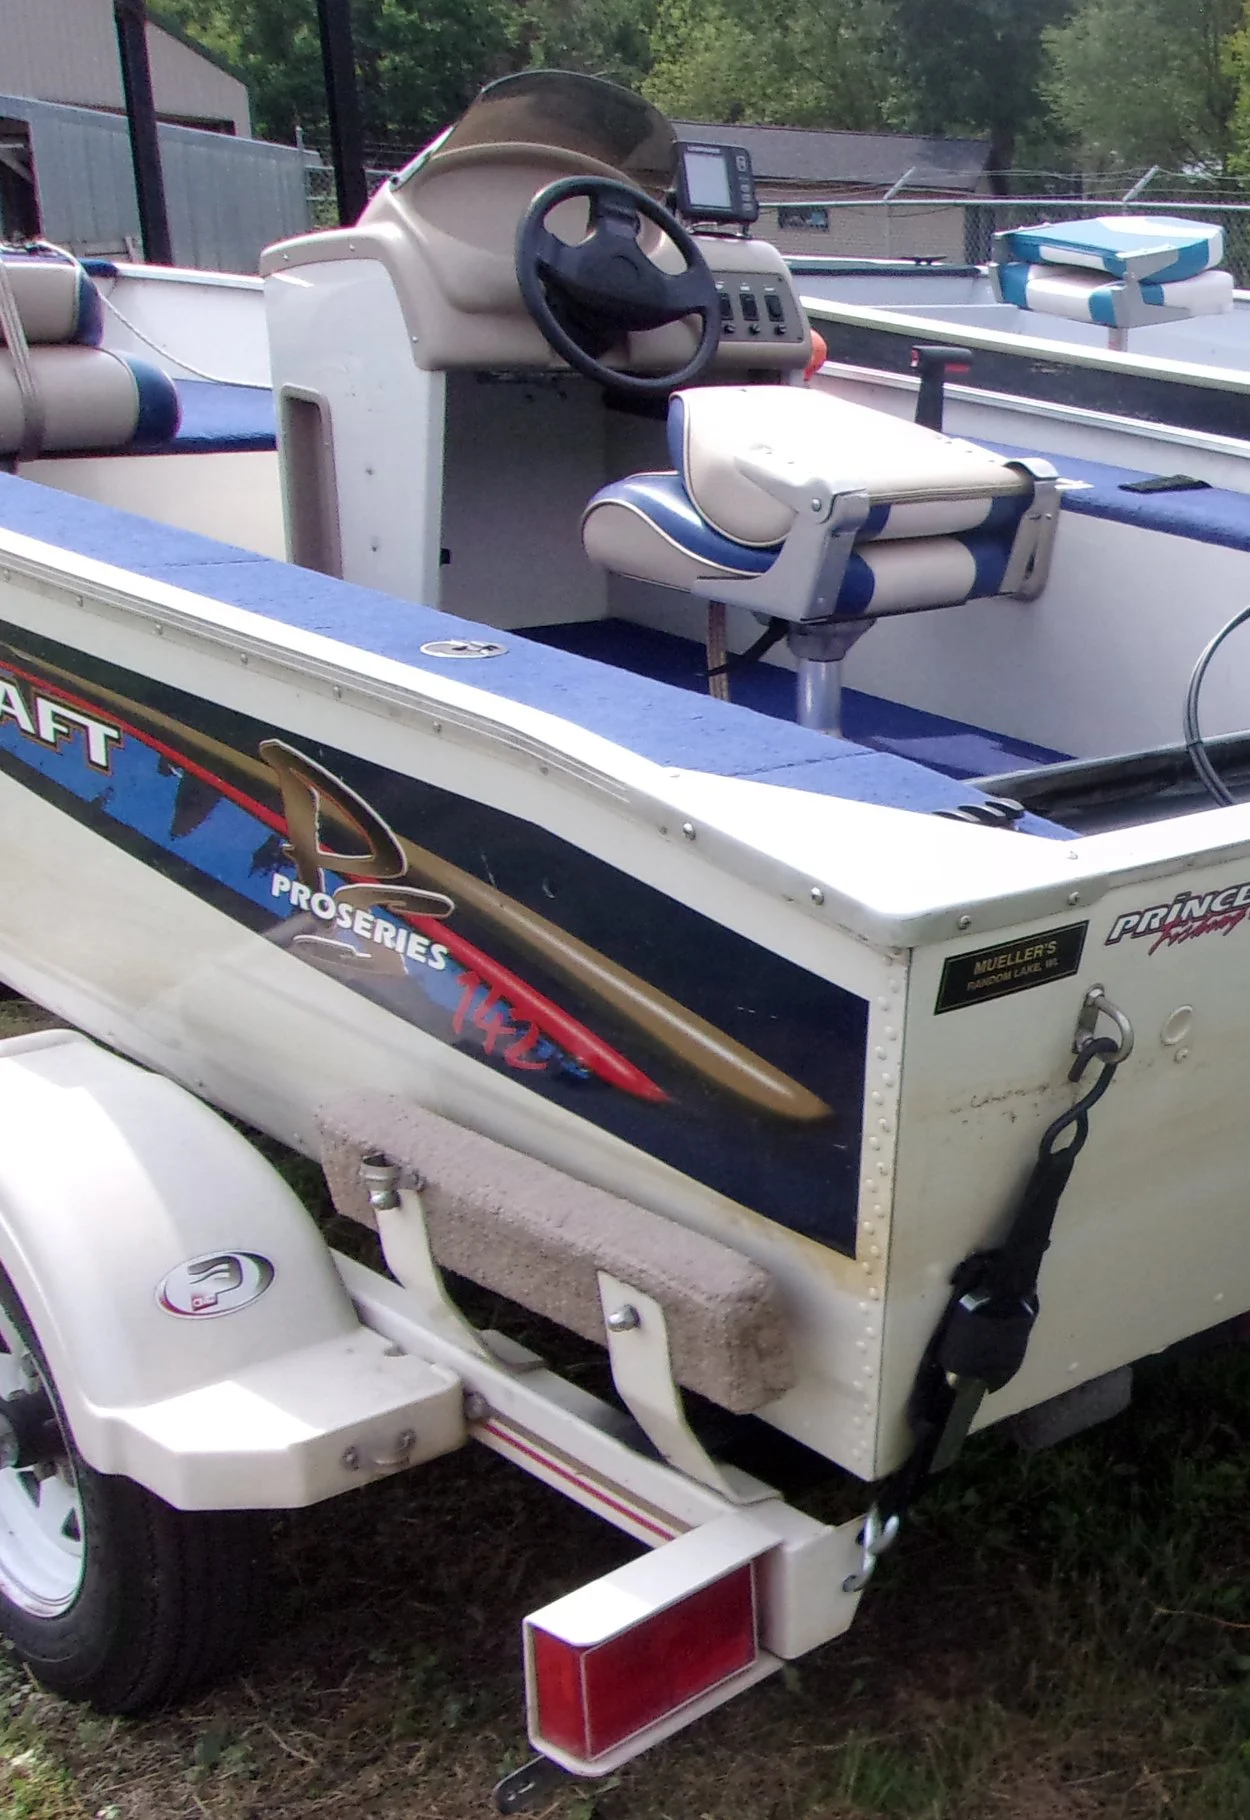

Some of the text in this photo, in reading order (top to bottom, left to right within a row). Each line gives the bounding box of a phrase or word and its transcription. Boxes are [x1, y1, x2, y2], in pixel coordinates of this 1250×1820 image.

[271, 873, 449, 971] PROSERIES
[973, 941, 1057, 976] MUELLER'S
[453, 971, 547, 1071] 142
